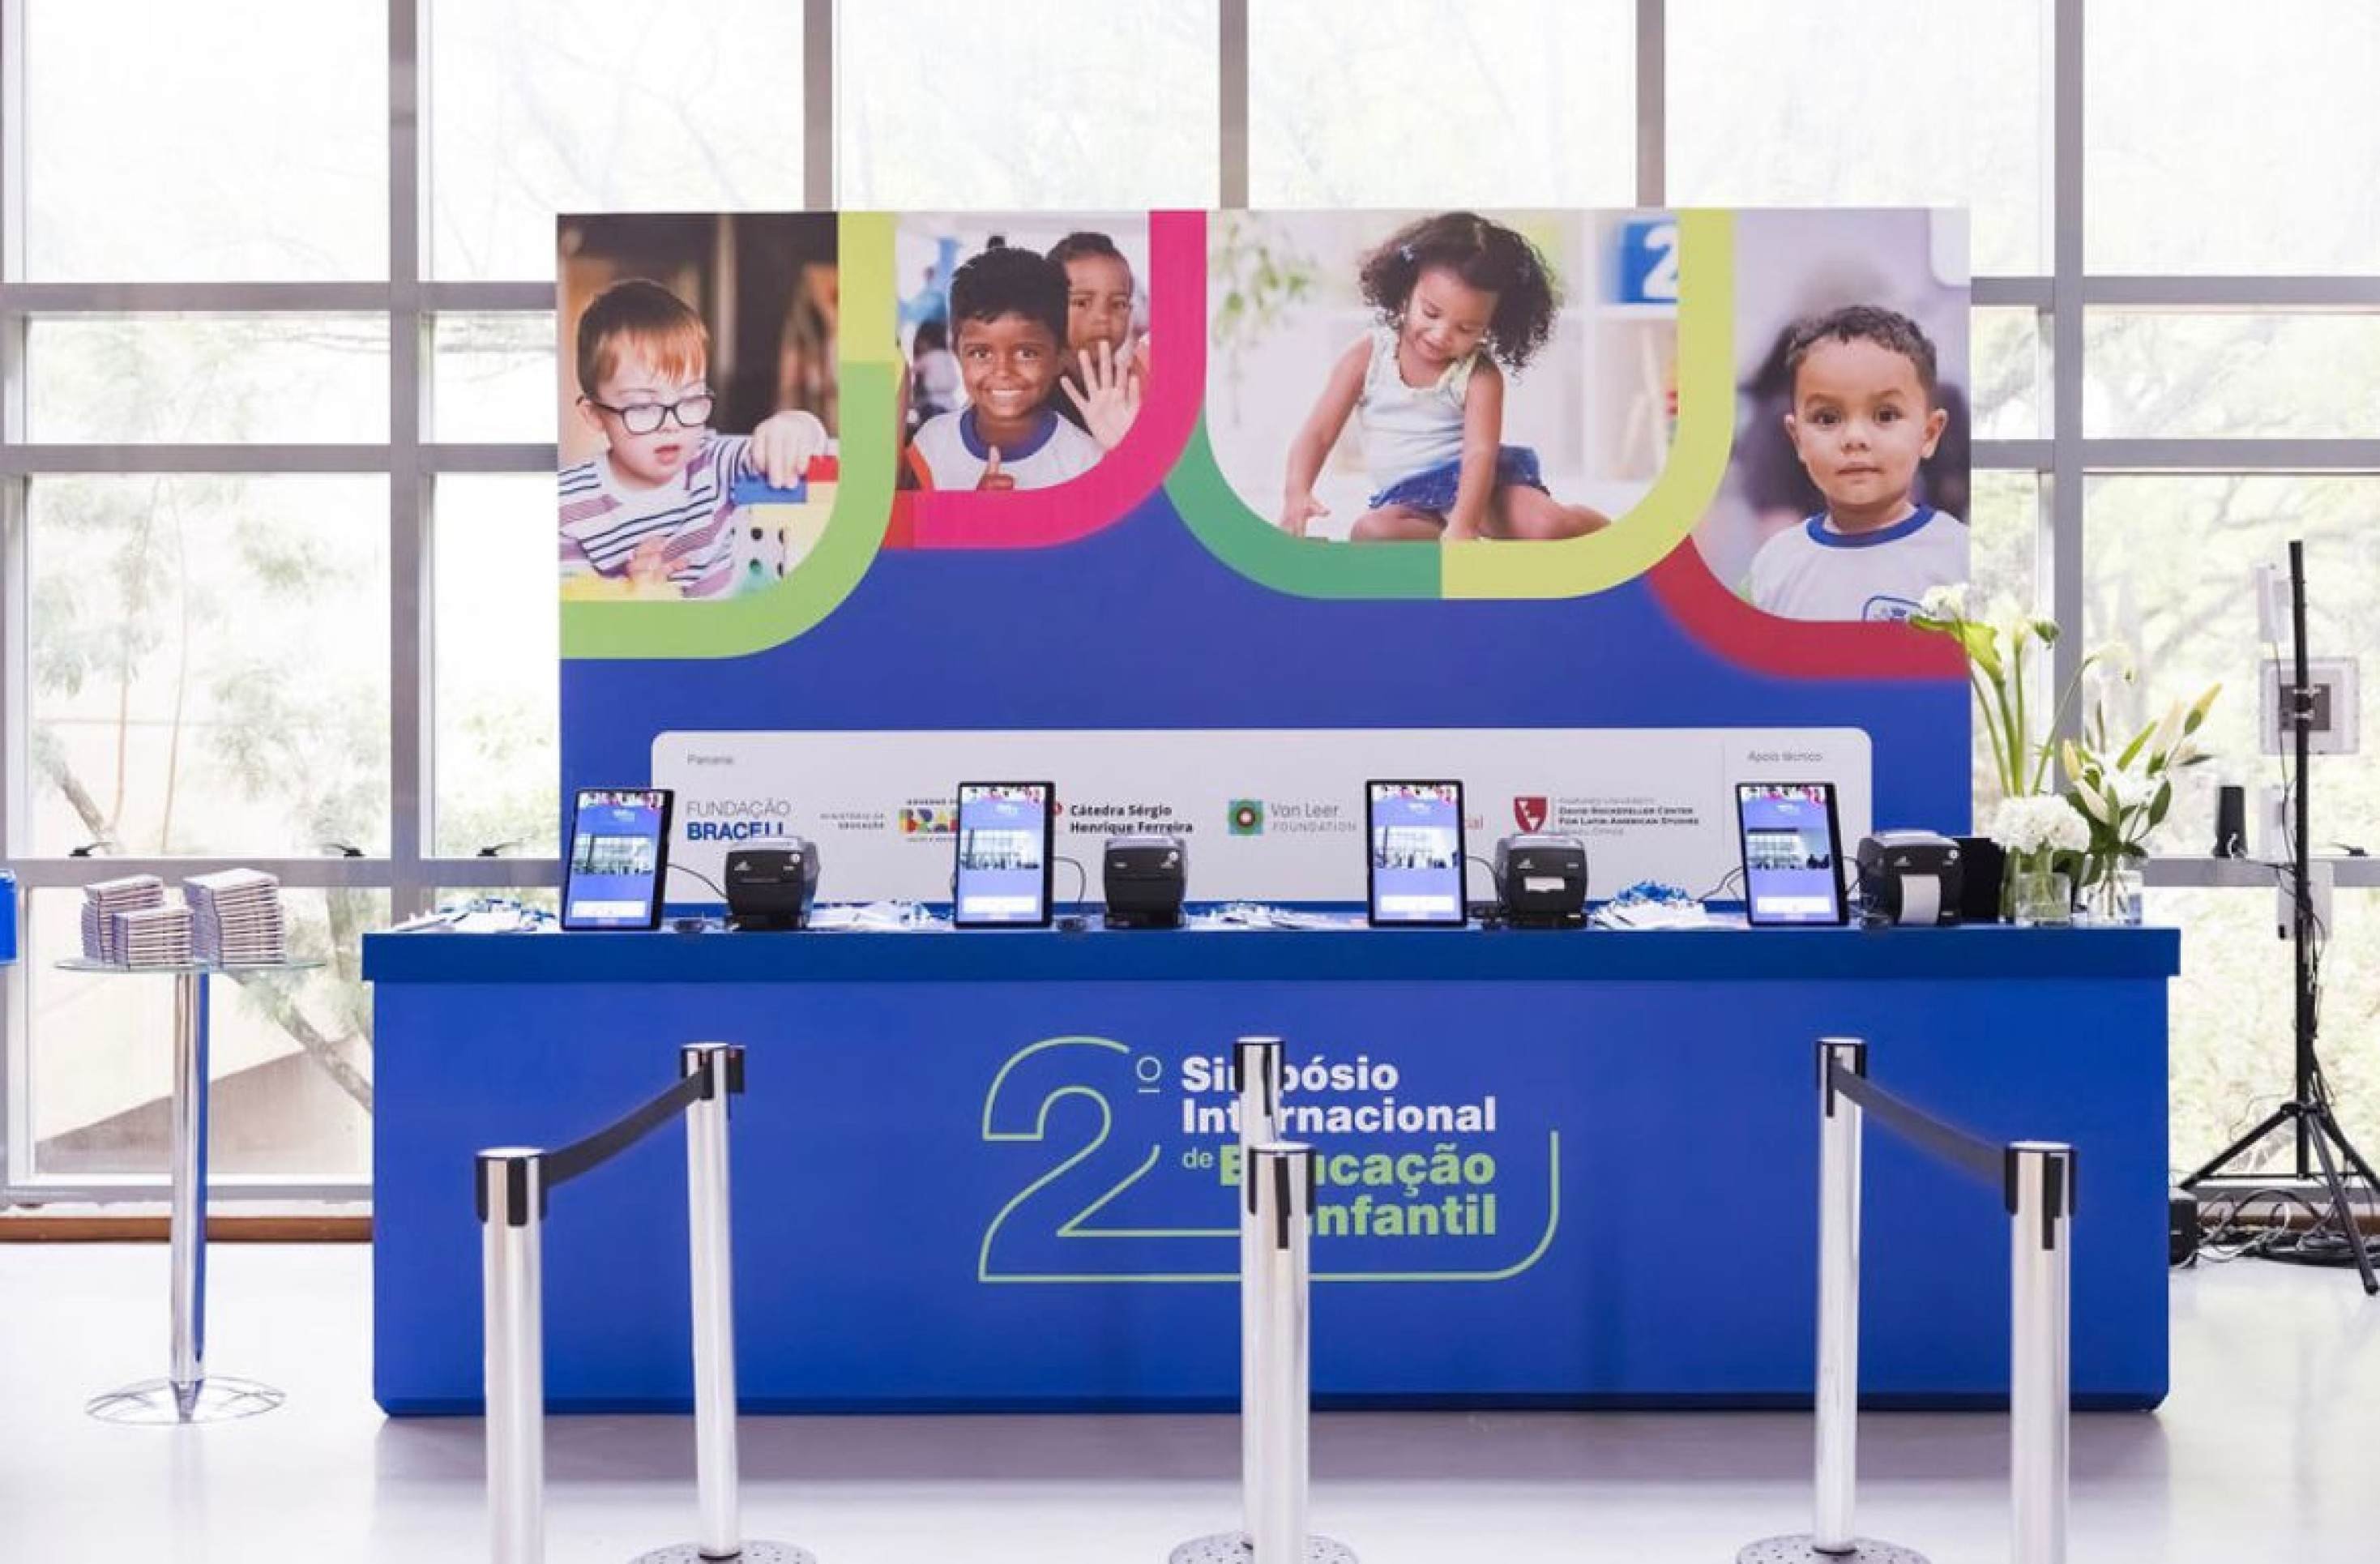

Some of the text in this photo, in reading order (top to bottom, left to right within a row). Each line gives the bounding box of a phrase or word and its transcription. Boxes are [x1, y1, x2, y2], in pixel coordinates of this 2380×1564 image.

[687, 797, 792, 818] FUNDAÇÃO
[1071, 801, 1173, 820] Cátedra Sérgio
[1271, 802, 1340, 818] Van Leer
[1071, 820, 1193, 835] Henrique Ferreira
[1272, 821, 1357, 832] FOUNDATION
[1180, 1056, 1399, 1092] Sipósio
[1181, 1097, 1497, 1132] Intrnacional
[1181, 1142, 1496, 1197] de Ecação
[1306, 1194, 1498, 1236] nfantil
